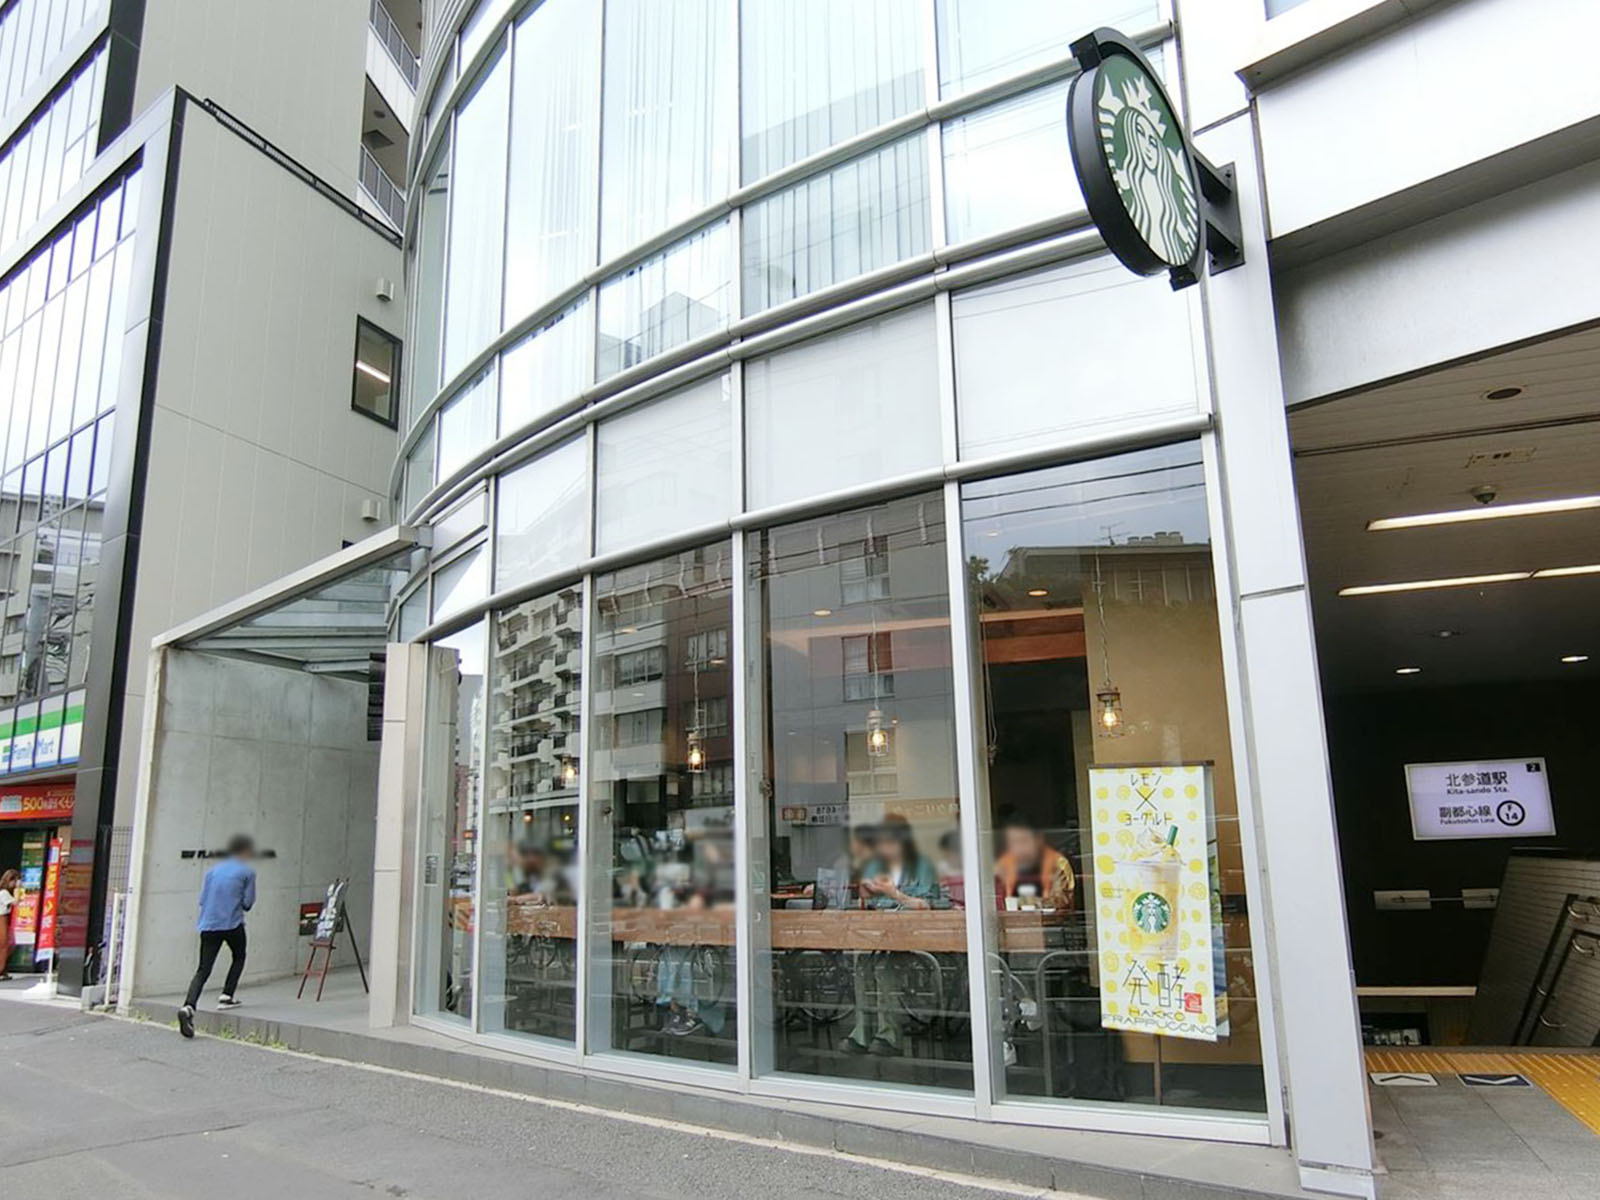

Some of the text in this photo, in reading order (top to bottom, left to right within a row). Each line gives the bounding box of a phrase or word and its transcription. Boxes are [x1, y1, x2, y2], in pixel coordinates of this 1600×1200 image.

[1130, 773, 1162, 787] レモン
[1445, 771, 1508, 787] 北参道駅
[1446, 786, 1510, 795] Kita-sando Sta.
[1439, 805, 1491, 818] 副都心線
[1505, 813, 1519, 821] 14
[1123, 812, 1173, 827] ヨーグルト
[1122, 959, 1187, 1011] 発酵
[1128, 1006, 1186, 1022] HAKKO
[1103, 1013, 1216, 1036] FRAPPUCCINO
